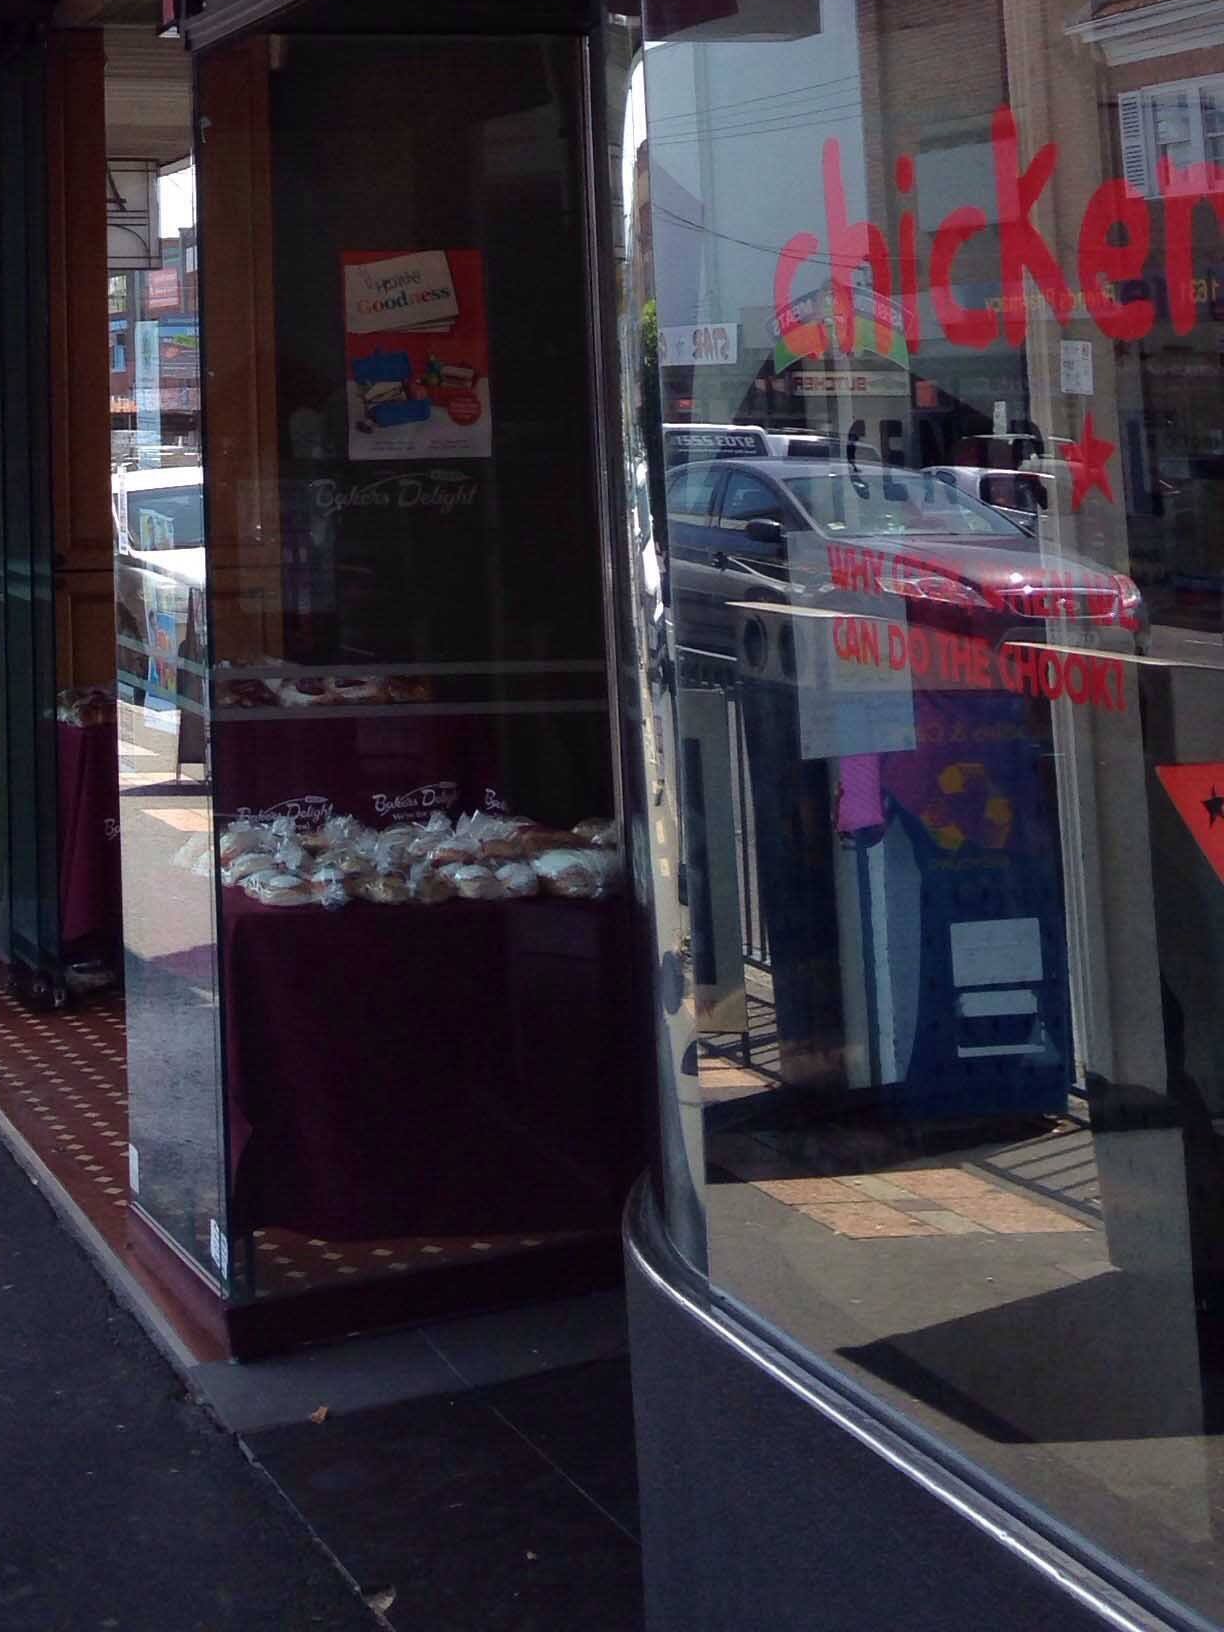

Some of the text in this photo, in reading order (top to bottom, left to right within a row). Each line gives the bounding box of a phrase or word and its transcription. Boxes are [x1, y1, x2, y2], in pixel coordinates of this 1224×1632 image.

[357, 285, 452, 314] Goodness
[397, 478, 481, 514] Delight
[832, 615, 881, 666] CAN
[888, 622, 927, 678] DO
[937, 629, 992, 694] THE
